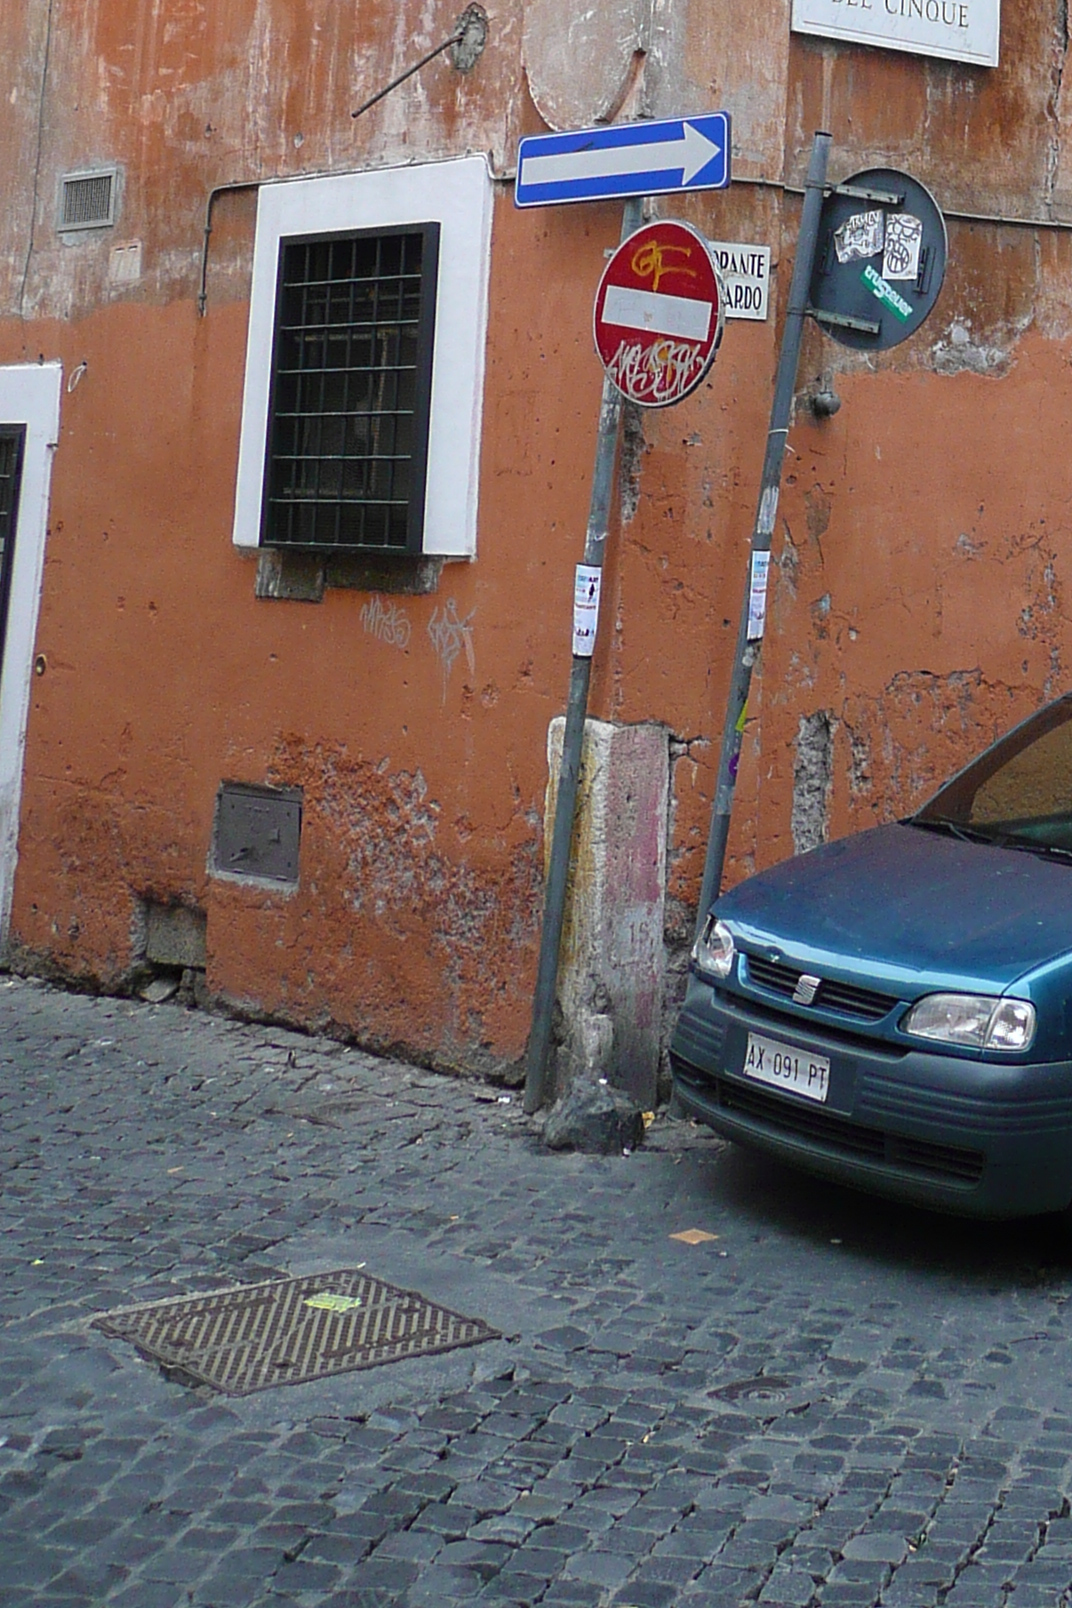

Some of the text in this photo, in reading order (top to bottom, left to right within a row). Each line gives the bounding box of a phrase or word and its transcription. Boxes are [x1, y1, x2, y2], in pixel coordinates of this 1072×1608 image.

[747, 1043, 827, 1091] AX 091 PT
